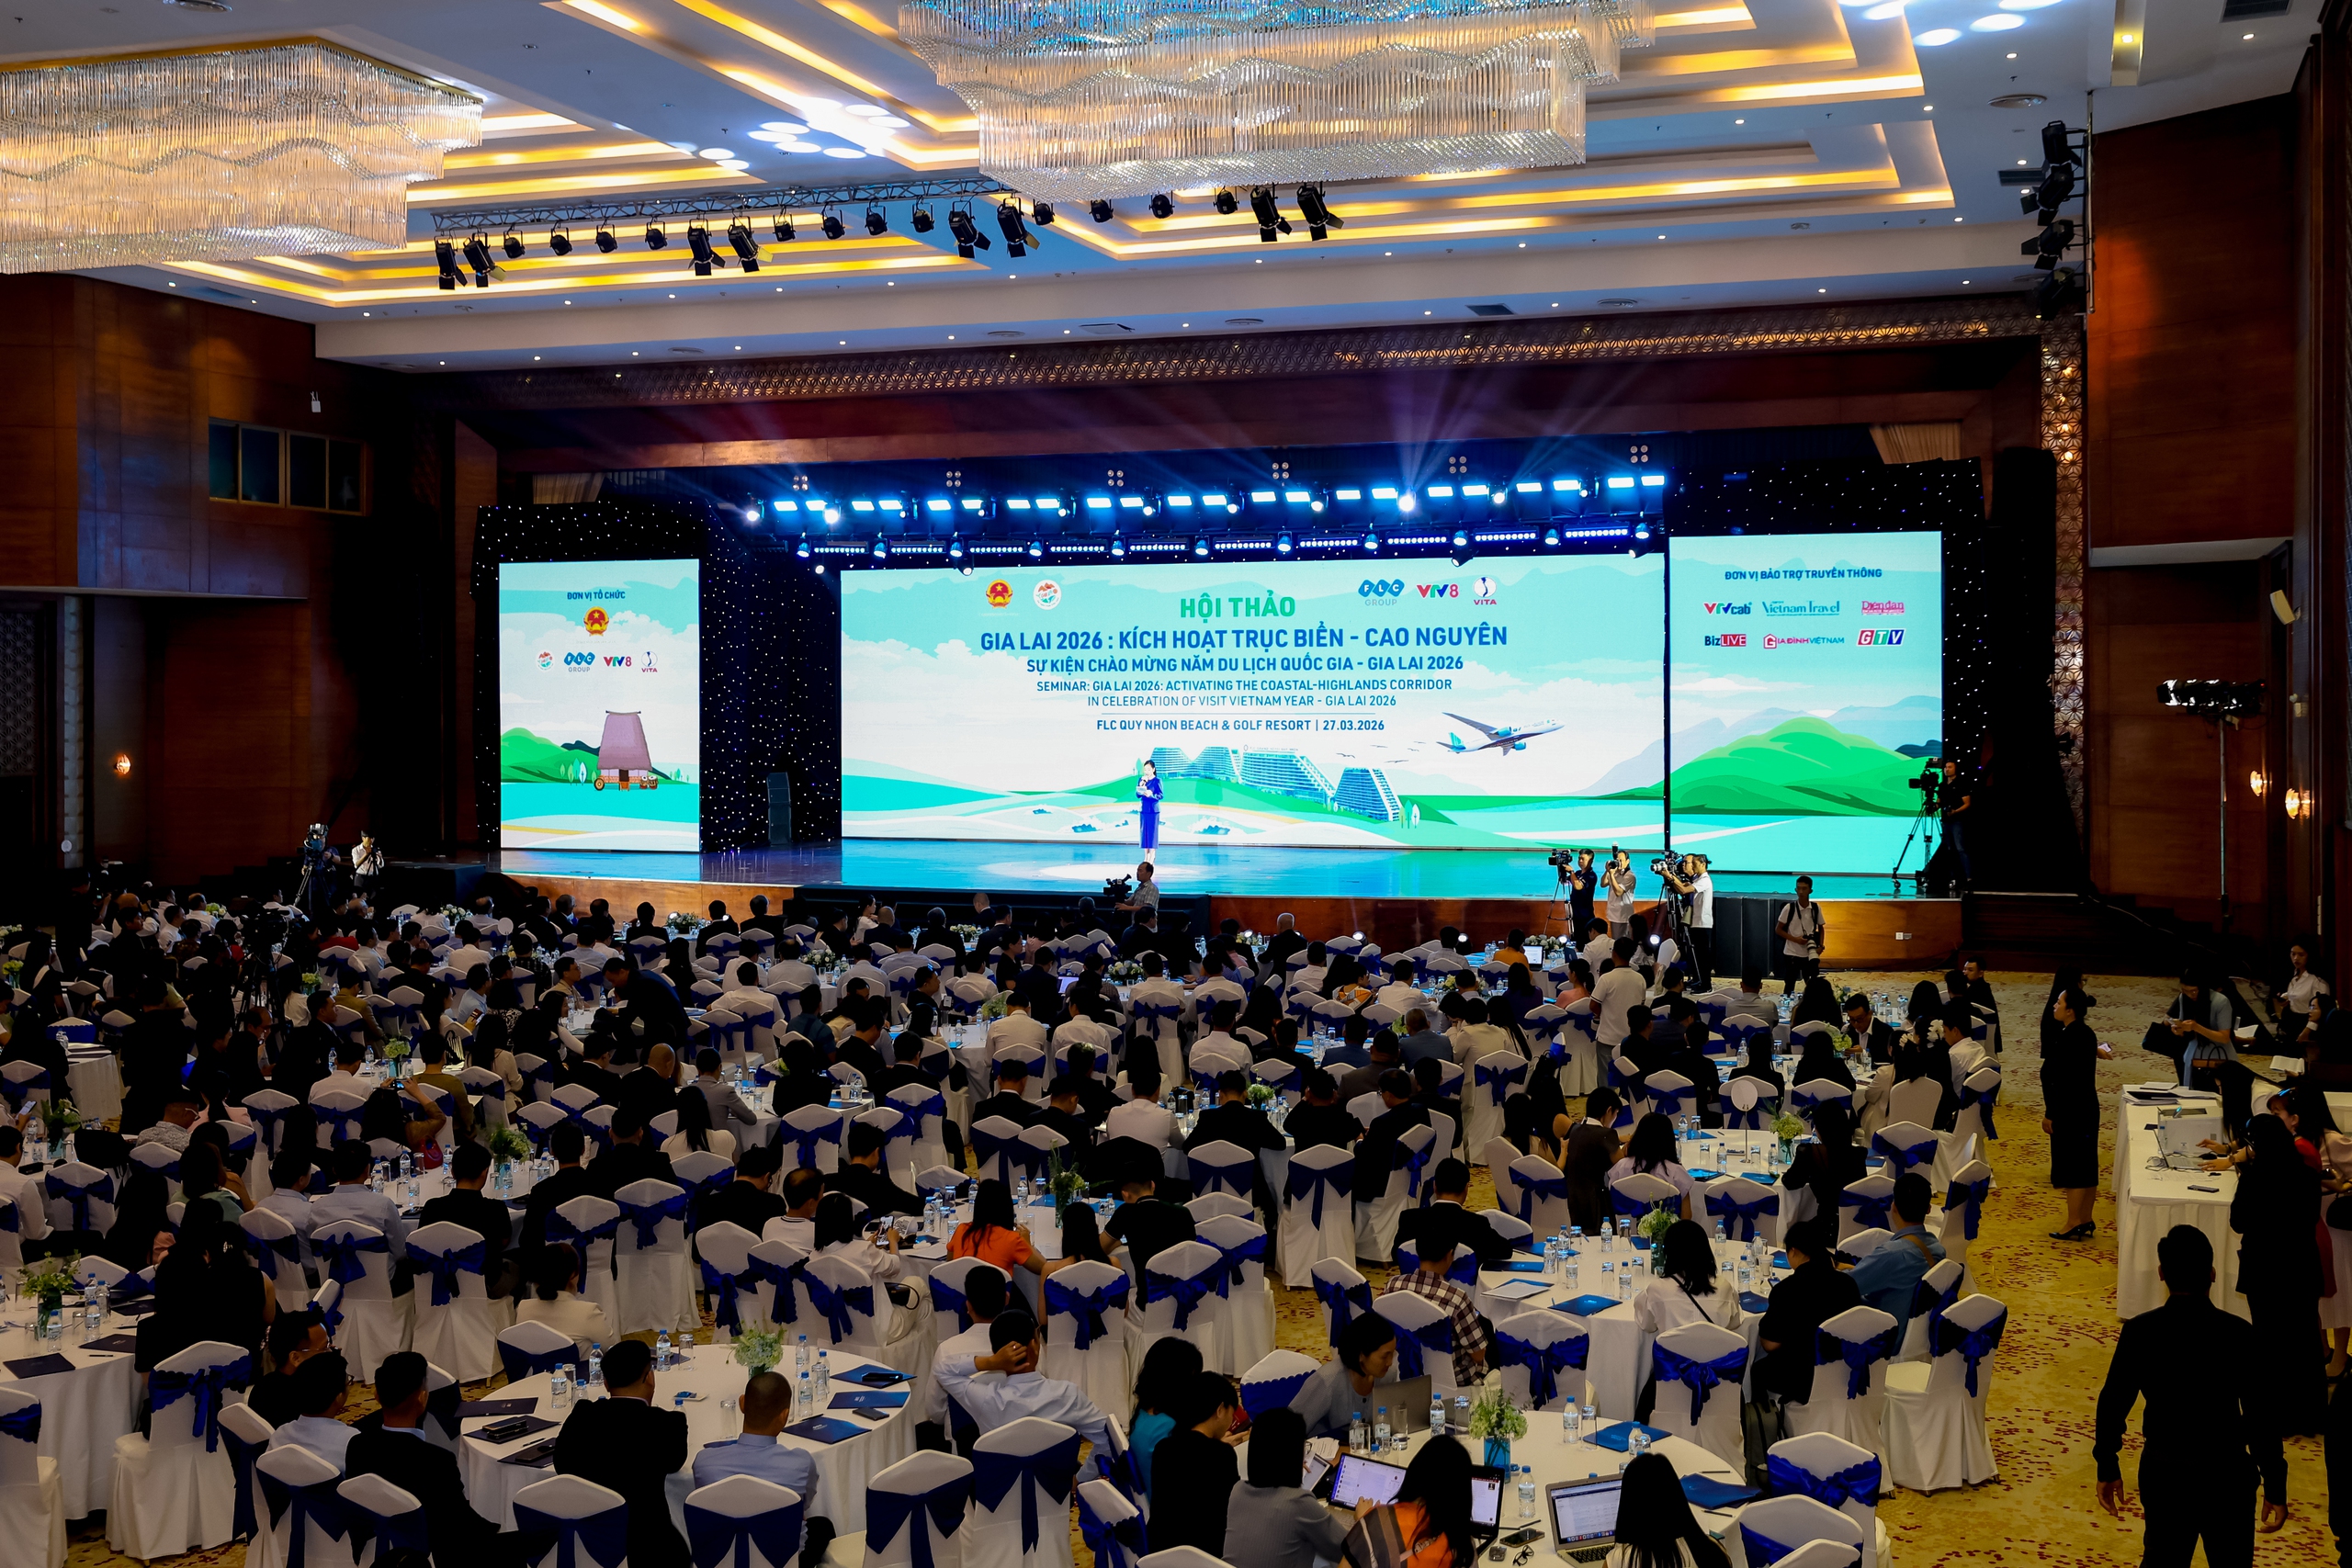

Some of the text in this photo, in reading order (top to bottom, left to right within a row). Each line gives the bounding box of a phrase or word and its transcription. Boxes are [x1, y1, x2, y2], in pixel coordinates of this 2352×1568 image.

[1724, 567, 1883, 581] ĐƠN VỊ BẢO TRỢ TRUYỀN THÔNG
[567, 589, 626, 602] ĐƠN VỊ TỔ CHỨC
[1416, 583, 1459, 598] VTV8
[1181, 590, 1297, 624] HỘI THẢO
[1703, 603, 1751, 615] VTVcab
[1762, 600, 1840, 613] Vietnam Travel
[980, 633, 1015, 650] GIA
[1020, 632, 1051, 649] LAI
[1057, 631, 1102, 649] 2026
[1119, 626, 1166, 649] KÍCH
[1173, 629, 1227, 653] HOẠT
[1231, 629, 1288, 652] TRỤC
[1295, 621, 1343, 648] BIỂN
[1365, 627, 1409, 647] CAO
[1417, 621, 1507, 646] NGUYÊN
[1704, 634, 1747, 647] BizLIVE
[1860, 630, 1904, 645] GTV
[1027, 659, 1047, 675] SỰ
[1051, 656, 1084, 675] KIỆN
[1089, 655, 1127, 671] CHÀO
[1132, 655, 1177, 671] MỪNG
[1182, 655, 1214, 671] NĂM
[1218, 658, 1238, 671] DU
[1243, 657, 1276, 674] LỊCH
[1281, 652, 1323, 671] QUỐC
[1327, 657, 1353, 671] GIA
[1368, 657, 1395, 670] GIA
[1399, 657, 1422, 670] LAI
[1427, 656, 1463, 670] 2026
[1037, 679, 1452, 692] SEMINAR: GIA LAI 2026: ACTIVATING THE COASTAL-HIGHLANDS CORRIDOR
[1088, 696, 1099, 706] IN
[1102, 695, 1179, 706] CELEBRATION
[1182, 695, 1195, 706] OF
[1198, 695, 1227, 706] VISIT
[1229, 695, 1282, 706] VIETNAM
[1284, 695, 1314, 706] YEAR
[1325, 695, 1345, 705] GIA
[1349, 695, 1366, 705] LAI
[1370, 695, 1396, 706] 2026
[1097, 720, 1117, 730] FLC
[1120, 720, 1142, 731] QUY
[1145, 720, 1177, 730] NHON
[1181, 720, 1219, 730] BEACH
[1222, 720, 1230, 730] &
[1234, 720, 1262, 730] GOLF
[1266, 720, 1311, 730] RESORT
[1323, 719, 1385, 731] 27.03.2026
